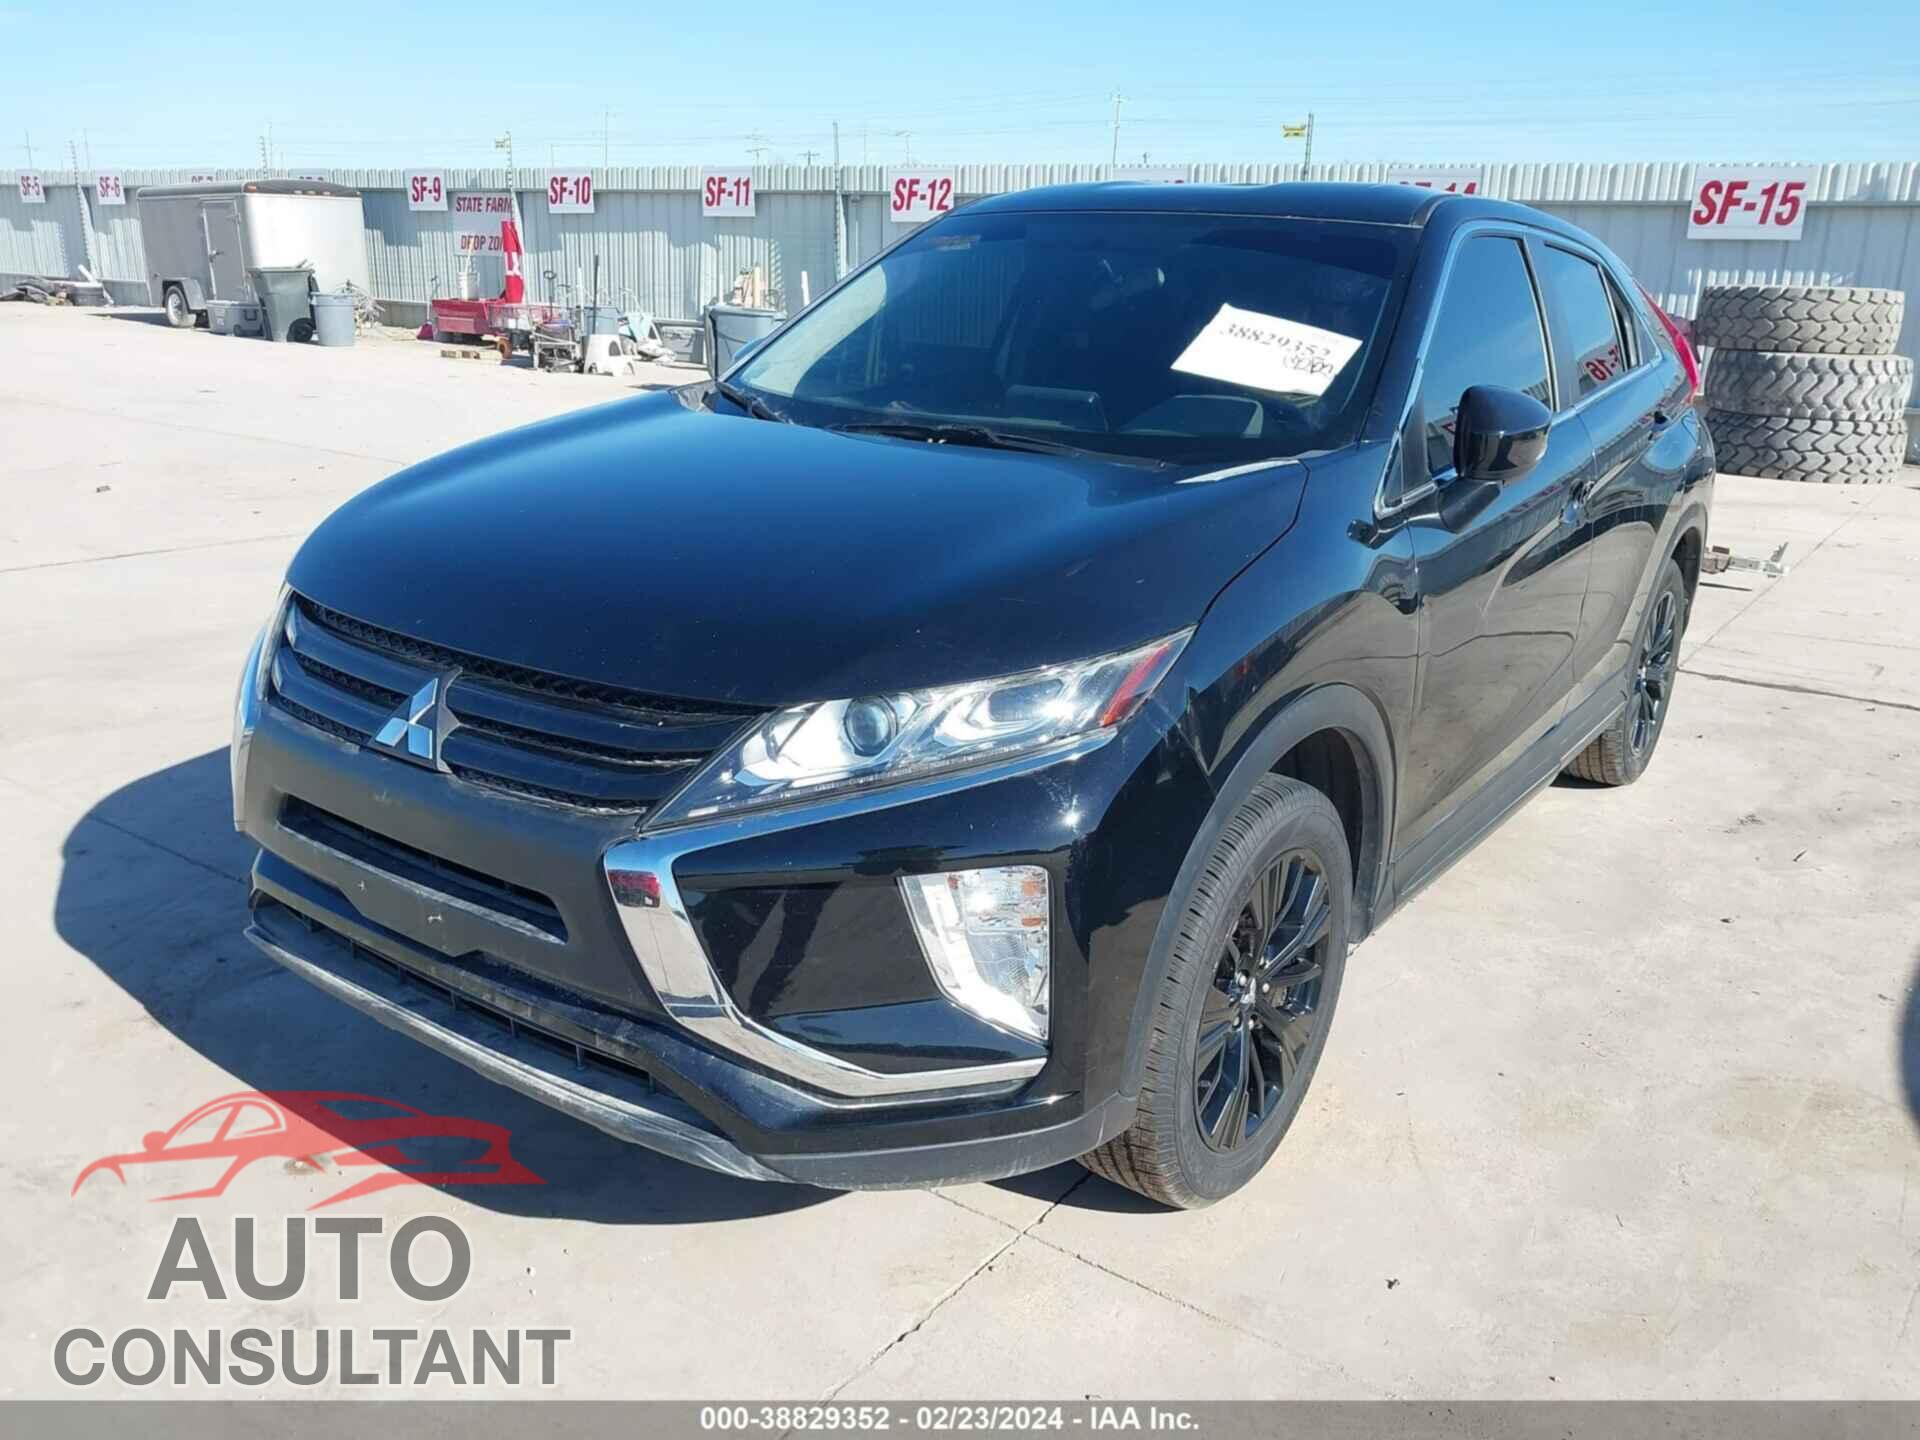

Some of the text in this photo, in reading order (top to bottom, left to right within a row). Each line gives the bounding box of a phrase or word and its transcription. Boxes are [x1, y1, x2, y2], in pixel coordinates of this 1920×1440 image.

[20, 175, 41, 197] SF-5
[99, 176, 121, 198] SF-6
[411, 176, 441, 203] SF-9
[549, 175, 592, 206] SF-10
[705, 176, 752, 208] SF-11
[892, 177, 954, 213] SF-12
[455, 197, 483, 213] STATE
[1692, 179, 1807, 227] SF-15
[1219, 323, 1332, 357] 38829352
